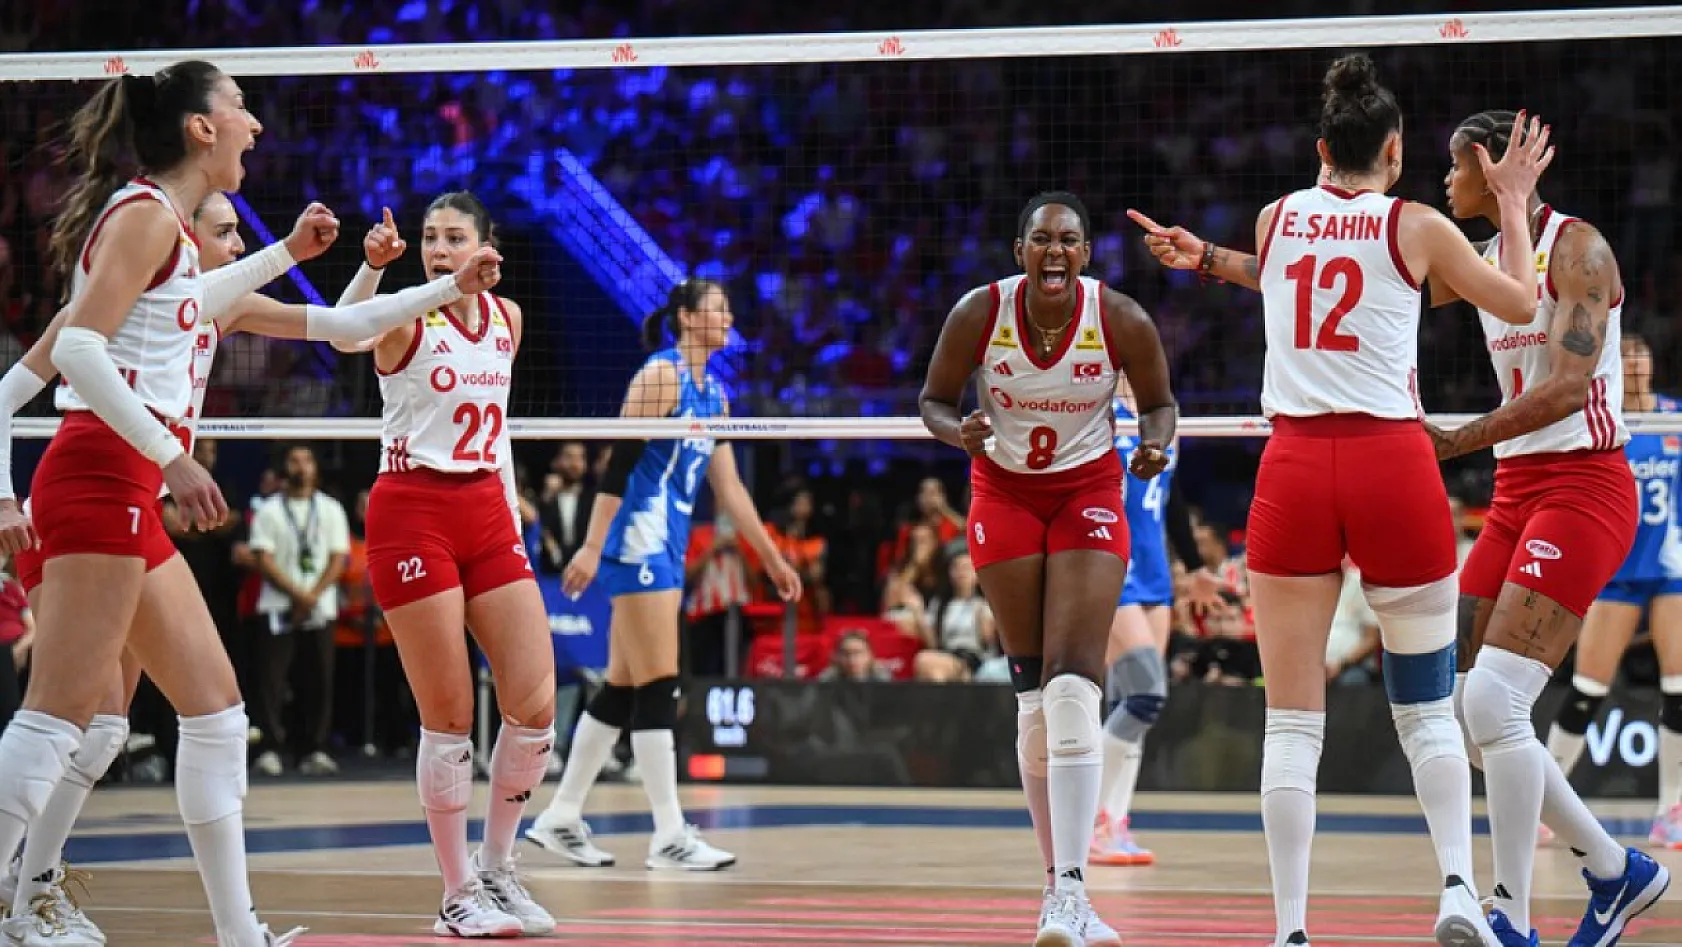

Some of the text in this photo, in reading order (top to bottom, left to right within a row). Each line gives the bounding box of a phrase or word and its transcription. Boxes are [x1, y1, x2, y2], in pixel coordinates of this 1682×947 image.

[1284, 254, 1364, 352] 12
[1017, 399, 1097, 413] vodafone
[452, 402, 503, 463] 22
[1026, 425, 1057, 470] 8
[1141, 476, 1162, 522] 4
[127, 506, 140, 535] 7
[974, 521, 986, 545] 8
[398, 557, 427, 583] 22
[637, 561, 655, 586] 6
